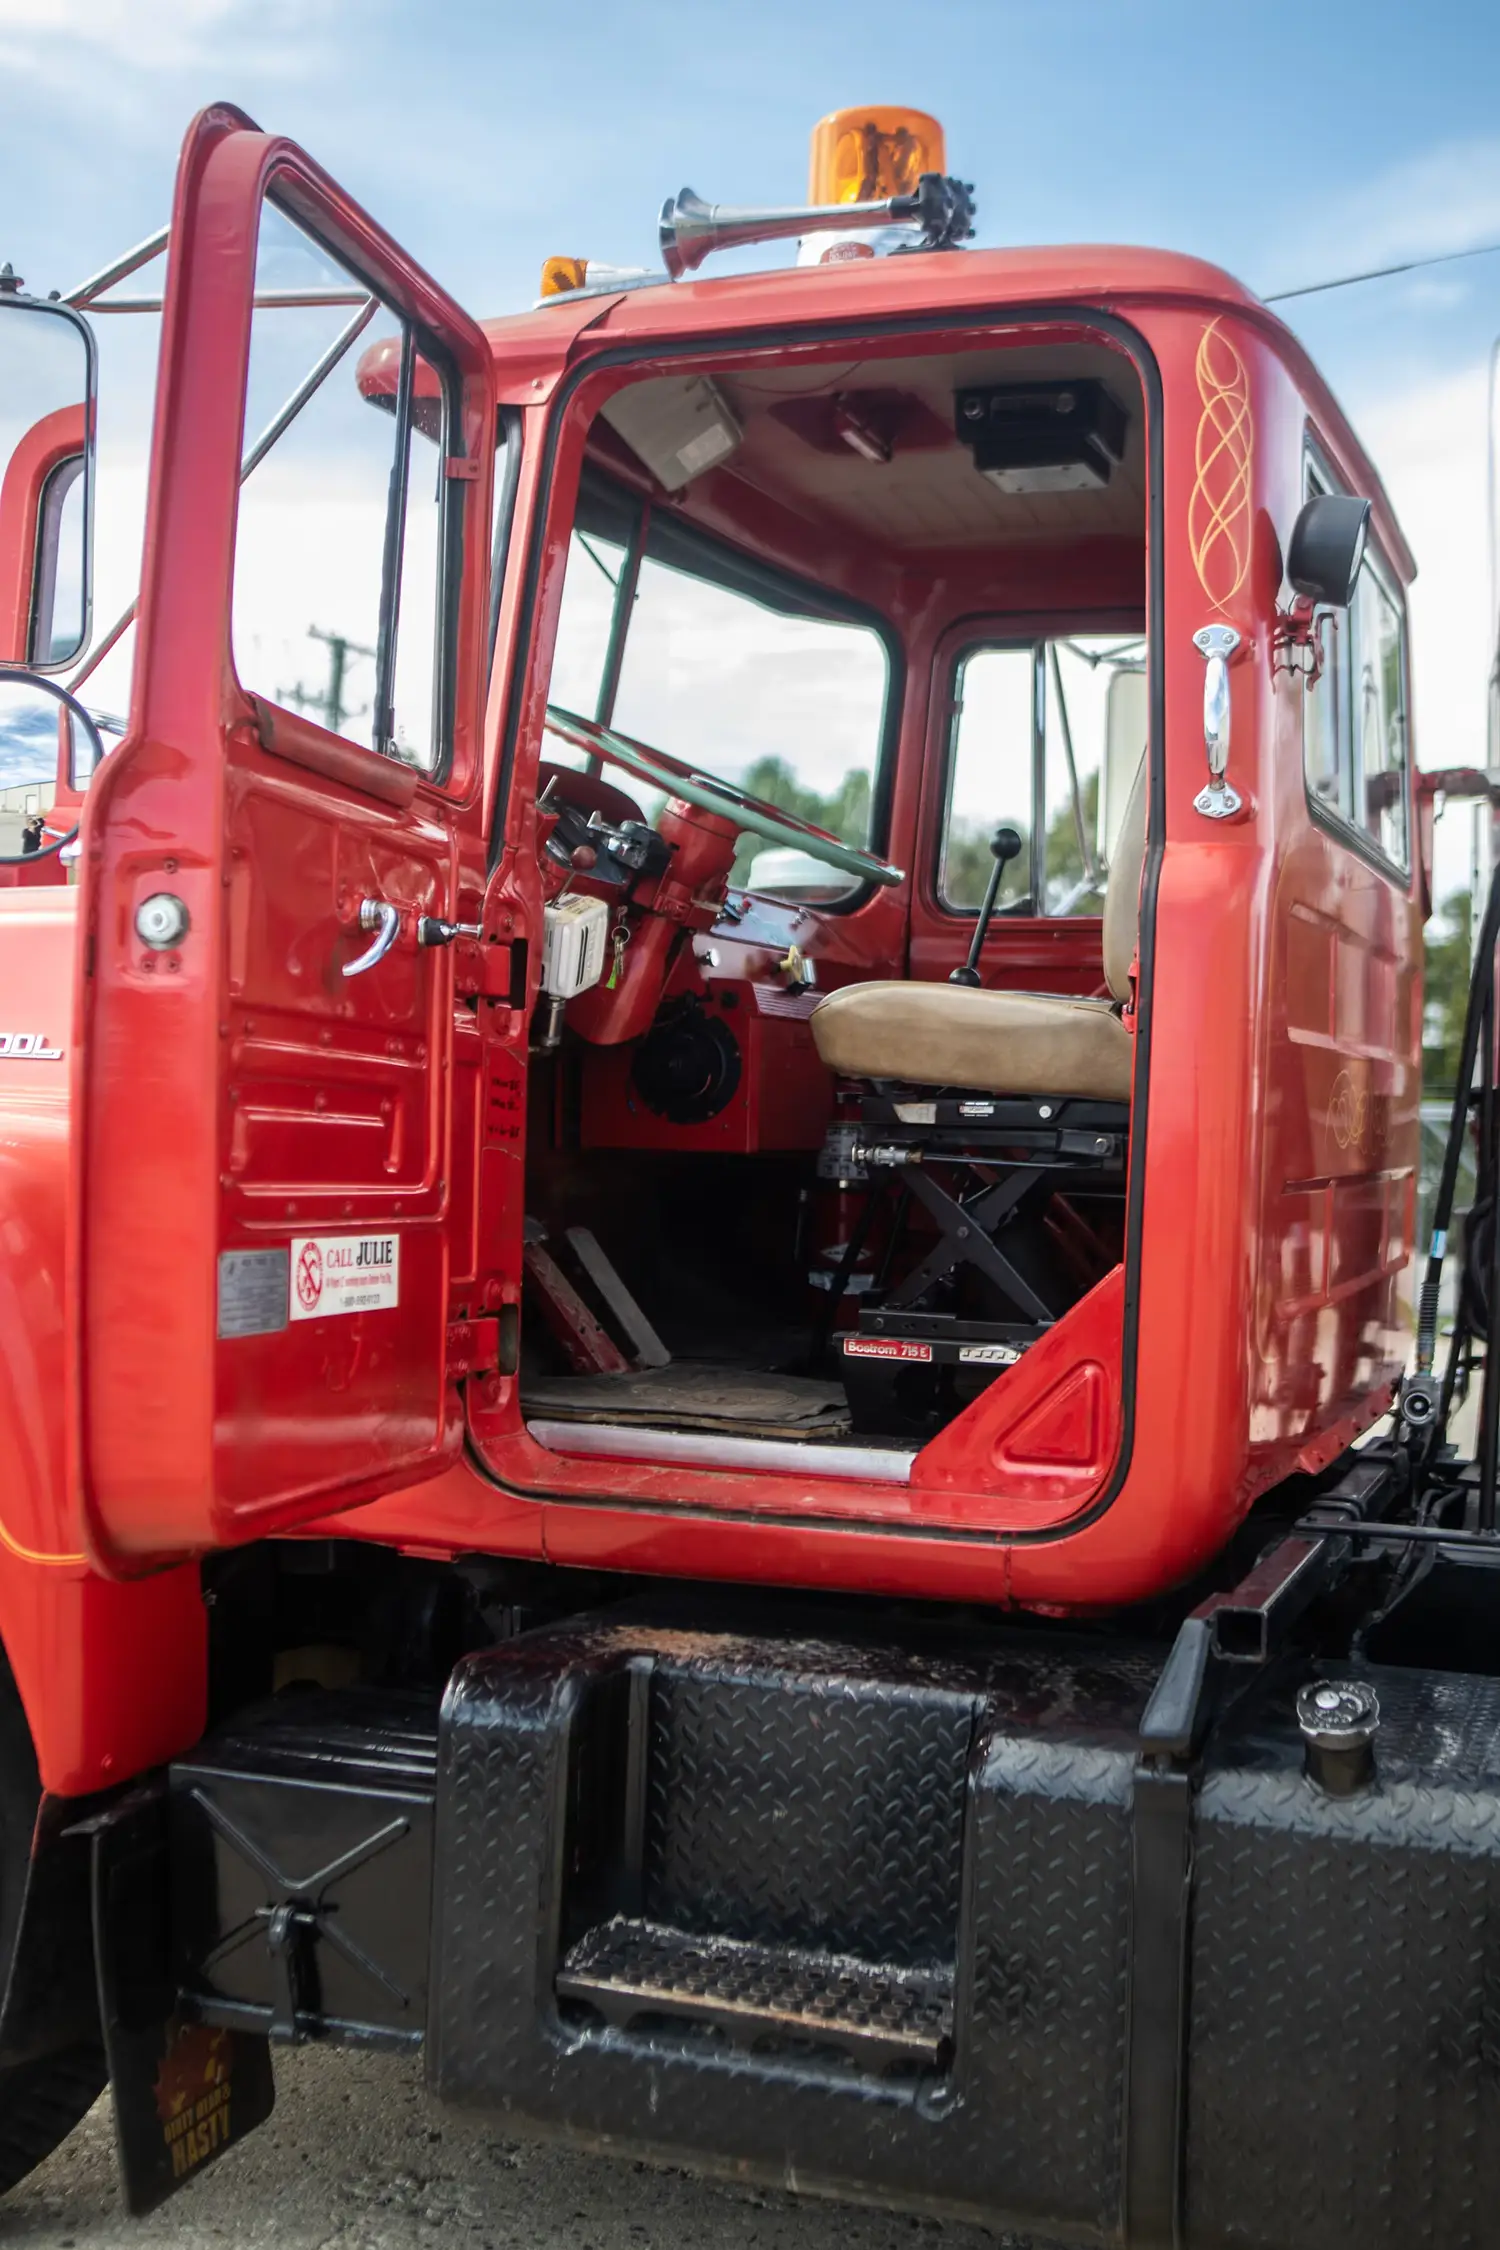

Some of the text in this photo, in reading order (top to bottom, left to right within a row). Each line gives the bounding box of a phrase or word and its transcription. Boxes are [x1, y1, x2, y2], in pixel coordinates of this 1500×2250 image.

[326, 1240, 393, 1268] CALL JULIE
[848, 1341, 898, 1355] Bostrom
[171, 2102, 231, 2178] NASTY
